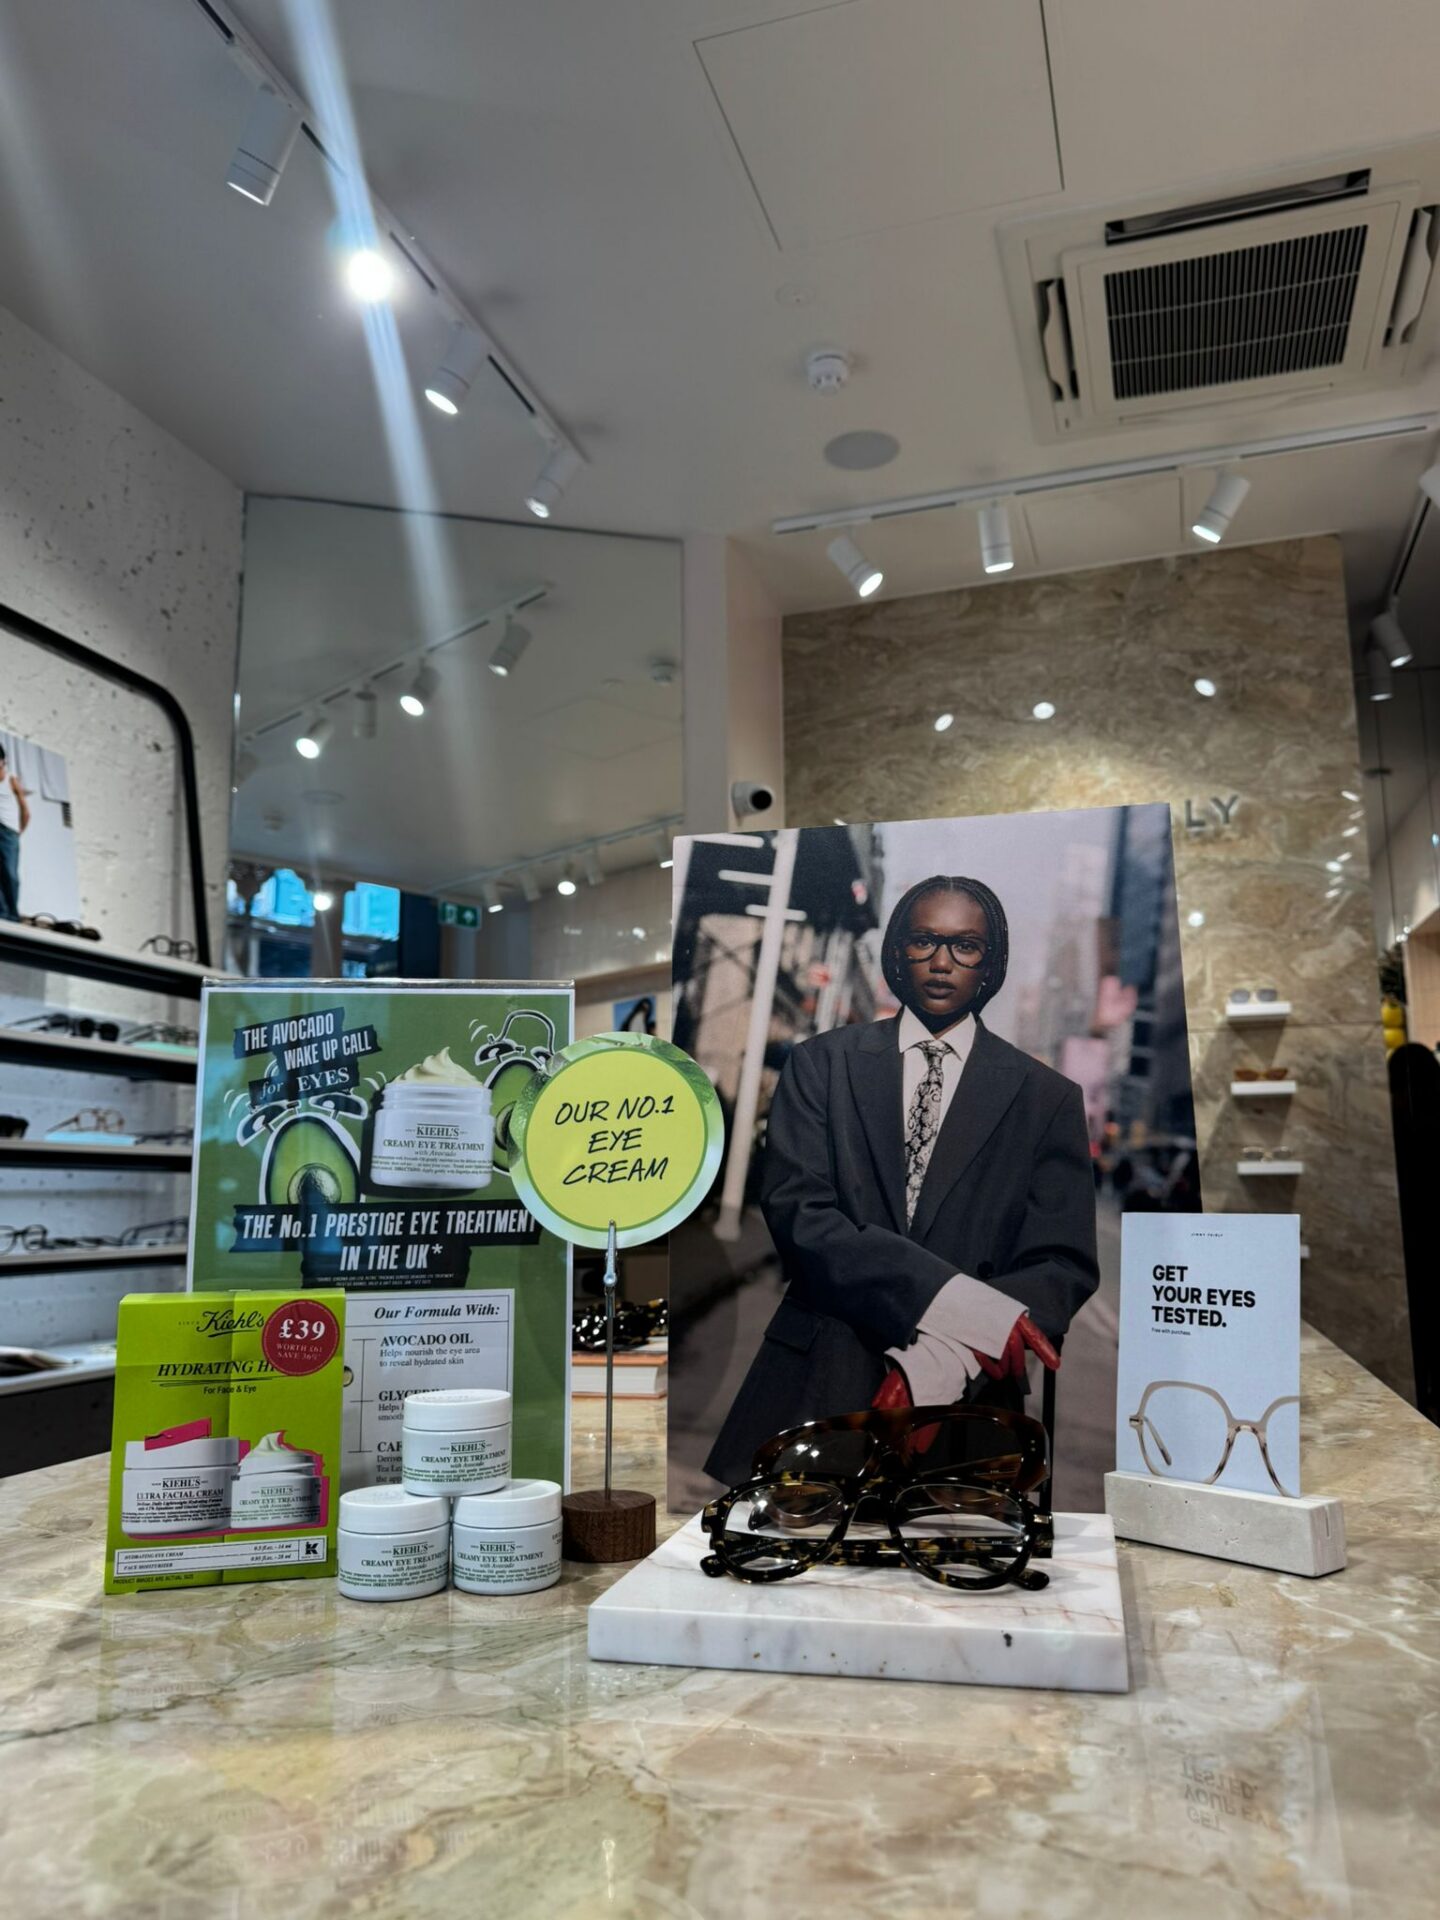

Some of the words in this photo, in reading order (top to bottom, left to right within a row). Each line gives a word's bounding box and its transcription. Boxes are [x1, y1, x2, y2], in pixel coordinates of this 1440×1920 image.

[1184, 795, 1239, 827] LY
[242, 1027, 268, 1051] THE
[272, 1013, 334, 1046] AVOCADO
[284, 1043, 320, 1071] WAKE
[322, 1039, 338, 1061] UP
[342, 1031, 372, 1056] CALL
[260, 1081, 284, 1099] for
[296, 1067, 350, 1092] EYES
[555, 1100, 610, 1125] OUR
[617, 1095, 674, 1119] NO.1
[416, 1126, 460, 1137] KIEHL'S
[383, 1139, 416, 1149] CREAMY
[418, 1140, 437, 1149] EYE
[439, 1142, 485, 1151] TREATMENT
[588, 1127, 642, 1154] EYE
[563, 1157, 669, 1185] CREAM
[242, 1214, 273, 1239] THE
[279, 1214, 316, 1239] No.1
[324, 1212, 404, 1238] PRESTIGE
[409, 1211, 440, 1236] EYE
[446, 1209, 536, 1235] TREATMENT
[340, 1245, 360, 1271] IN
[368, 1245, 398, 1270] THE
[1152, 1264, 1188, 1282] GET
[1152, 1285, 1202, 1304] YOUR
[1207, 1288, 1256, 1308] EYES
[374, 1307, 401, 1319] Our
[404, 1305, 461, 1318] Formula
[466, 1303, 500, 1316] With:
[1151, 1305, 1227, 1328] TESTED.
[196, 1310, 264, 1334] Kiehl's
[278, 1318, 326, 1340] £39
[276, 1343, 307, 1351] WORTH
[380, 1334, 446, 1347] AVOCADO
[450, 1333, 474, 1344] OIL
[380, 1349, 403, 1358] Helps
[405, 1348, 434, 1357] nourish
[436, 1347, 448, 1355] the
[449, 1348, 462, 1356] eye
[157, 1360, 254, 1377] HYDRATING
[414, 1357, 446, 1368] hydrated
[448, 1357, 465, 1365] skin
[204, 1386, 217, 1394] For
[217, 1386, 235, 1394] Face
[236, 1385, 241, 1393] &
[244, 1385, 257, 1393] Eye
[378, 1403, 400, 1413] Helps
[451, 1442, 486, 1452] KIEHL'S
[162, 1478, 201, 1488] KIEHL'S
[137, 1491, 161, 1500] ULTRA
[162, 1489, 195, 1499] FACIAL
[196, 1488, 224, 1497] CREAM
[393, 1543, 428, 1555] KIEHL'S
[480, 1543, 516, 1551] KIEHL'S
[361, 1559, 394, 1567] CREAMY
[395, 1558, 411, 1566] EYE
[499, 1551, 544, 1562] TREATMENT
